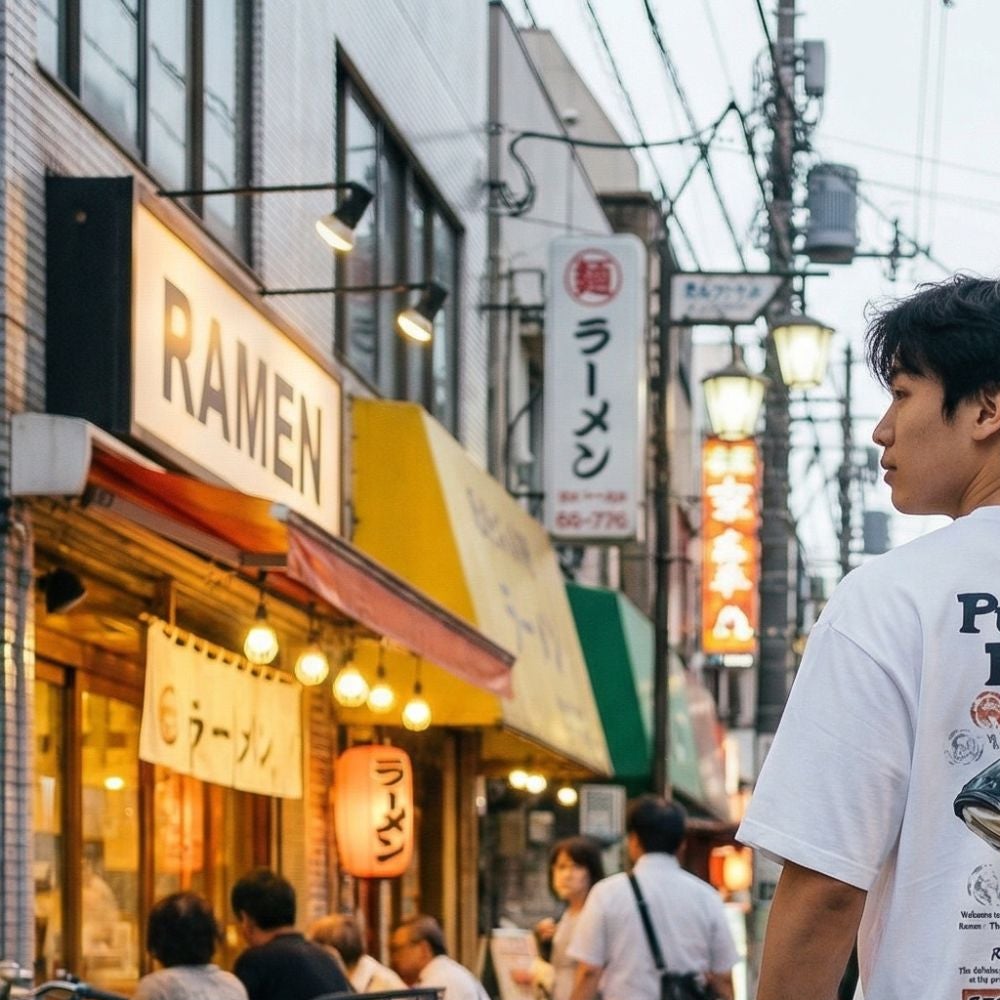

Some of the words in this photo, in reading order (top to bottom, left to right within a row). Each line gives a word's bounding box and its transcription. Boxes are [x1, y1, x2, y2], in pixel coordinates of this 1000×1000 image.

[162, 276, 323, 508] RAMEN
[572, 317, 611, 479] ラーメン
[376, 758, 404, 863] ラーメン
